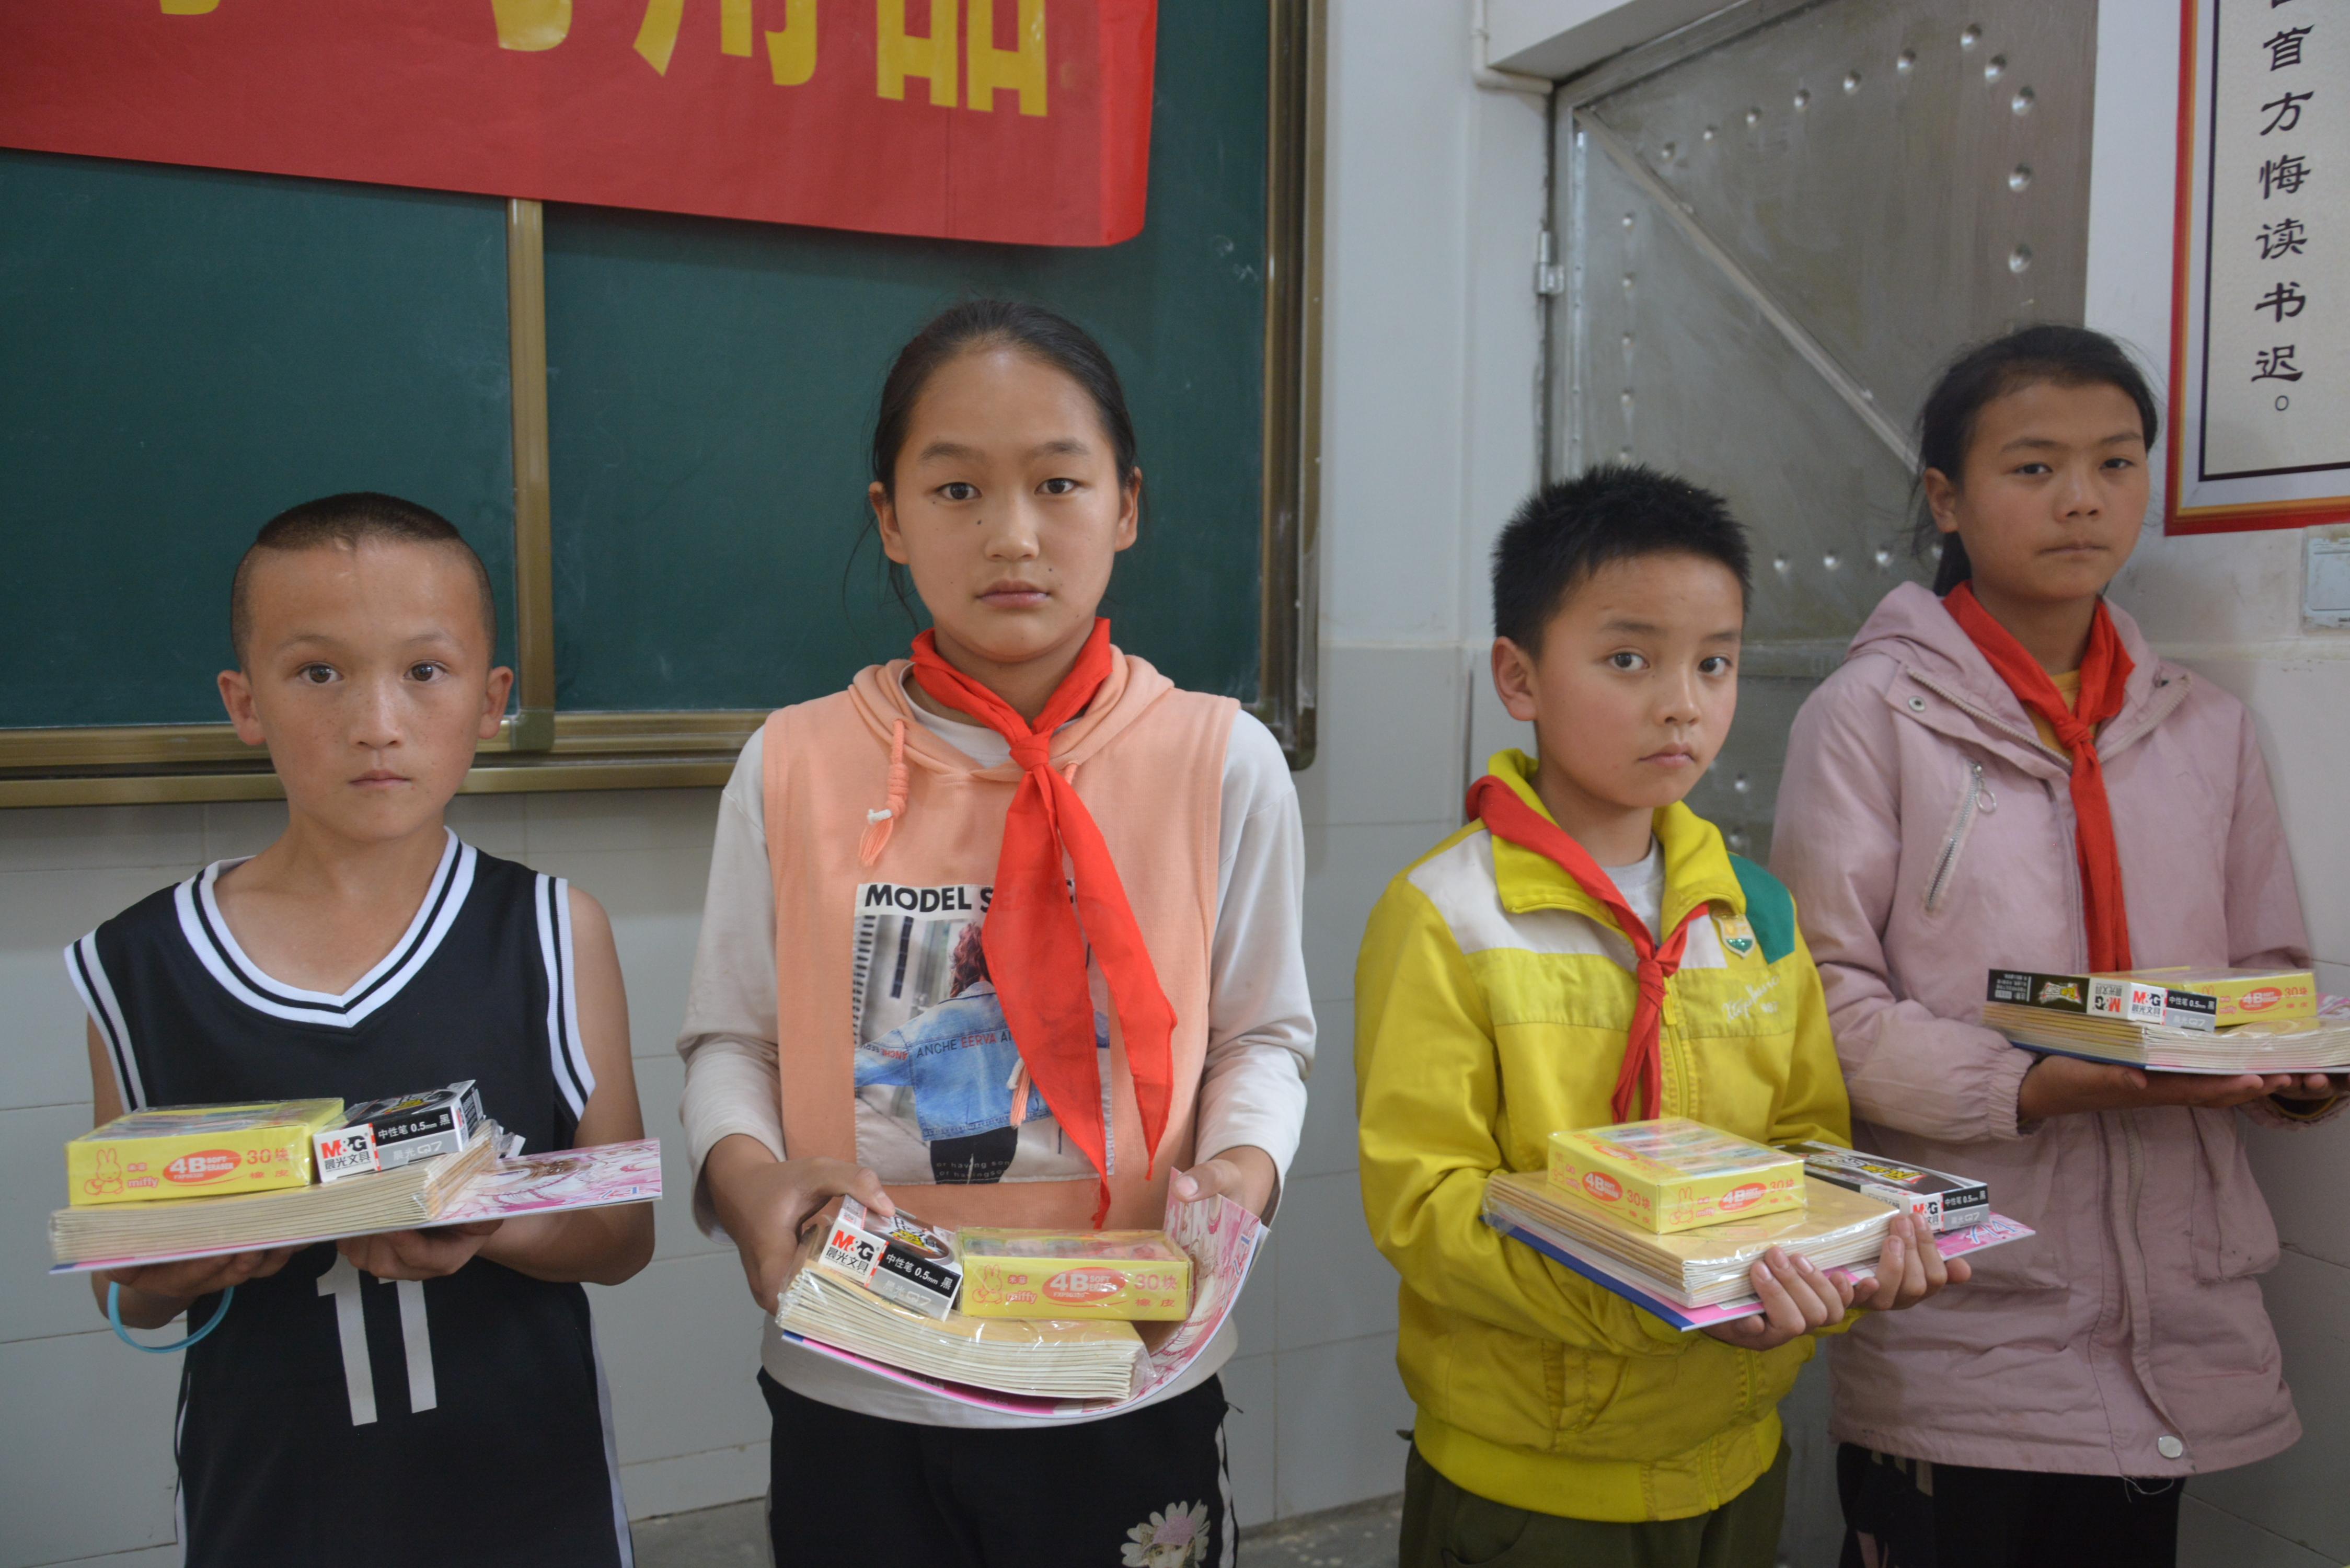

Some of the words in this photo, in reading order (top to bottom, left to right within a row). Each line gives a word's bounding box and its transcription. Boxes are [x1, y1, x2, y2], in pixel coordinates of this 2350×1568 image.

[2251, 0, 2315, 412] 首方悔读书迟。
[865, 884, 972, 913] MODEL
[2133, 990, 2162, 1006] M&G
[2169, 995, 2188, 1007] 中性笔
[2242, 992, 2262, 1004] 4B
[917, 1040, 957, 1058] ANCHE
[961, 1033, 997, 1048] EERVA
[378, 1124, 409, 1139] 中性笔
[440, 1114, 451, 1126] 黑
[320, 1135, 367, 1159] M&G
[169, 1157, 206, 1173] 4B
[325, 1151, 371, 1170] 晨光文具
[128, 1177, 158, 1189] miffy
[1585, 1172, 1606, 1191] 4B
[1724, 1189, 1745, 1204] 4B
[1967, 1220, 2018, 1244] A4
[832, 1229, 874, 1262] M&G
[826, 1247, 869, 1273] 晨光文具
[886, 1253, 914, 1273] 中性笔
[915, 1267, 938, 1285] 0.5mm
[940, 1276, 953, 1290] 黑
[1008, 1275, 1028, 1284] 米菲
[1050, 1273, 1089, 1292] 4B
[1006, 1290, 1038, 1305] miffy
